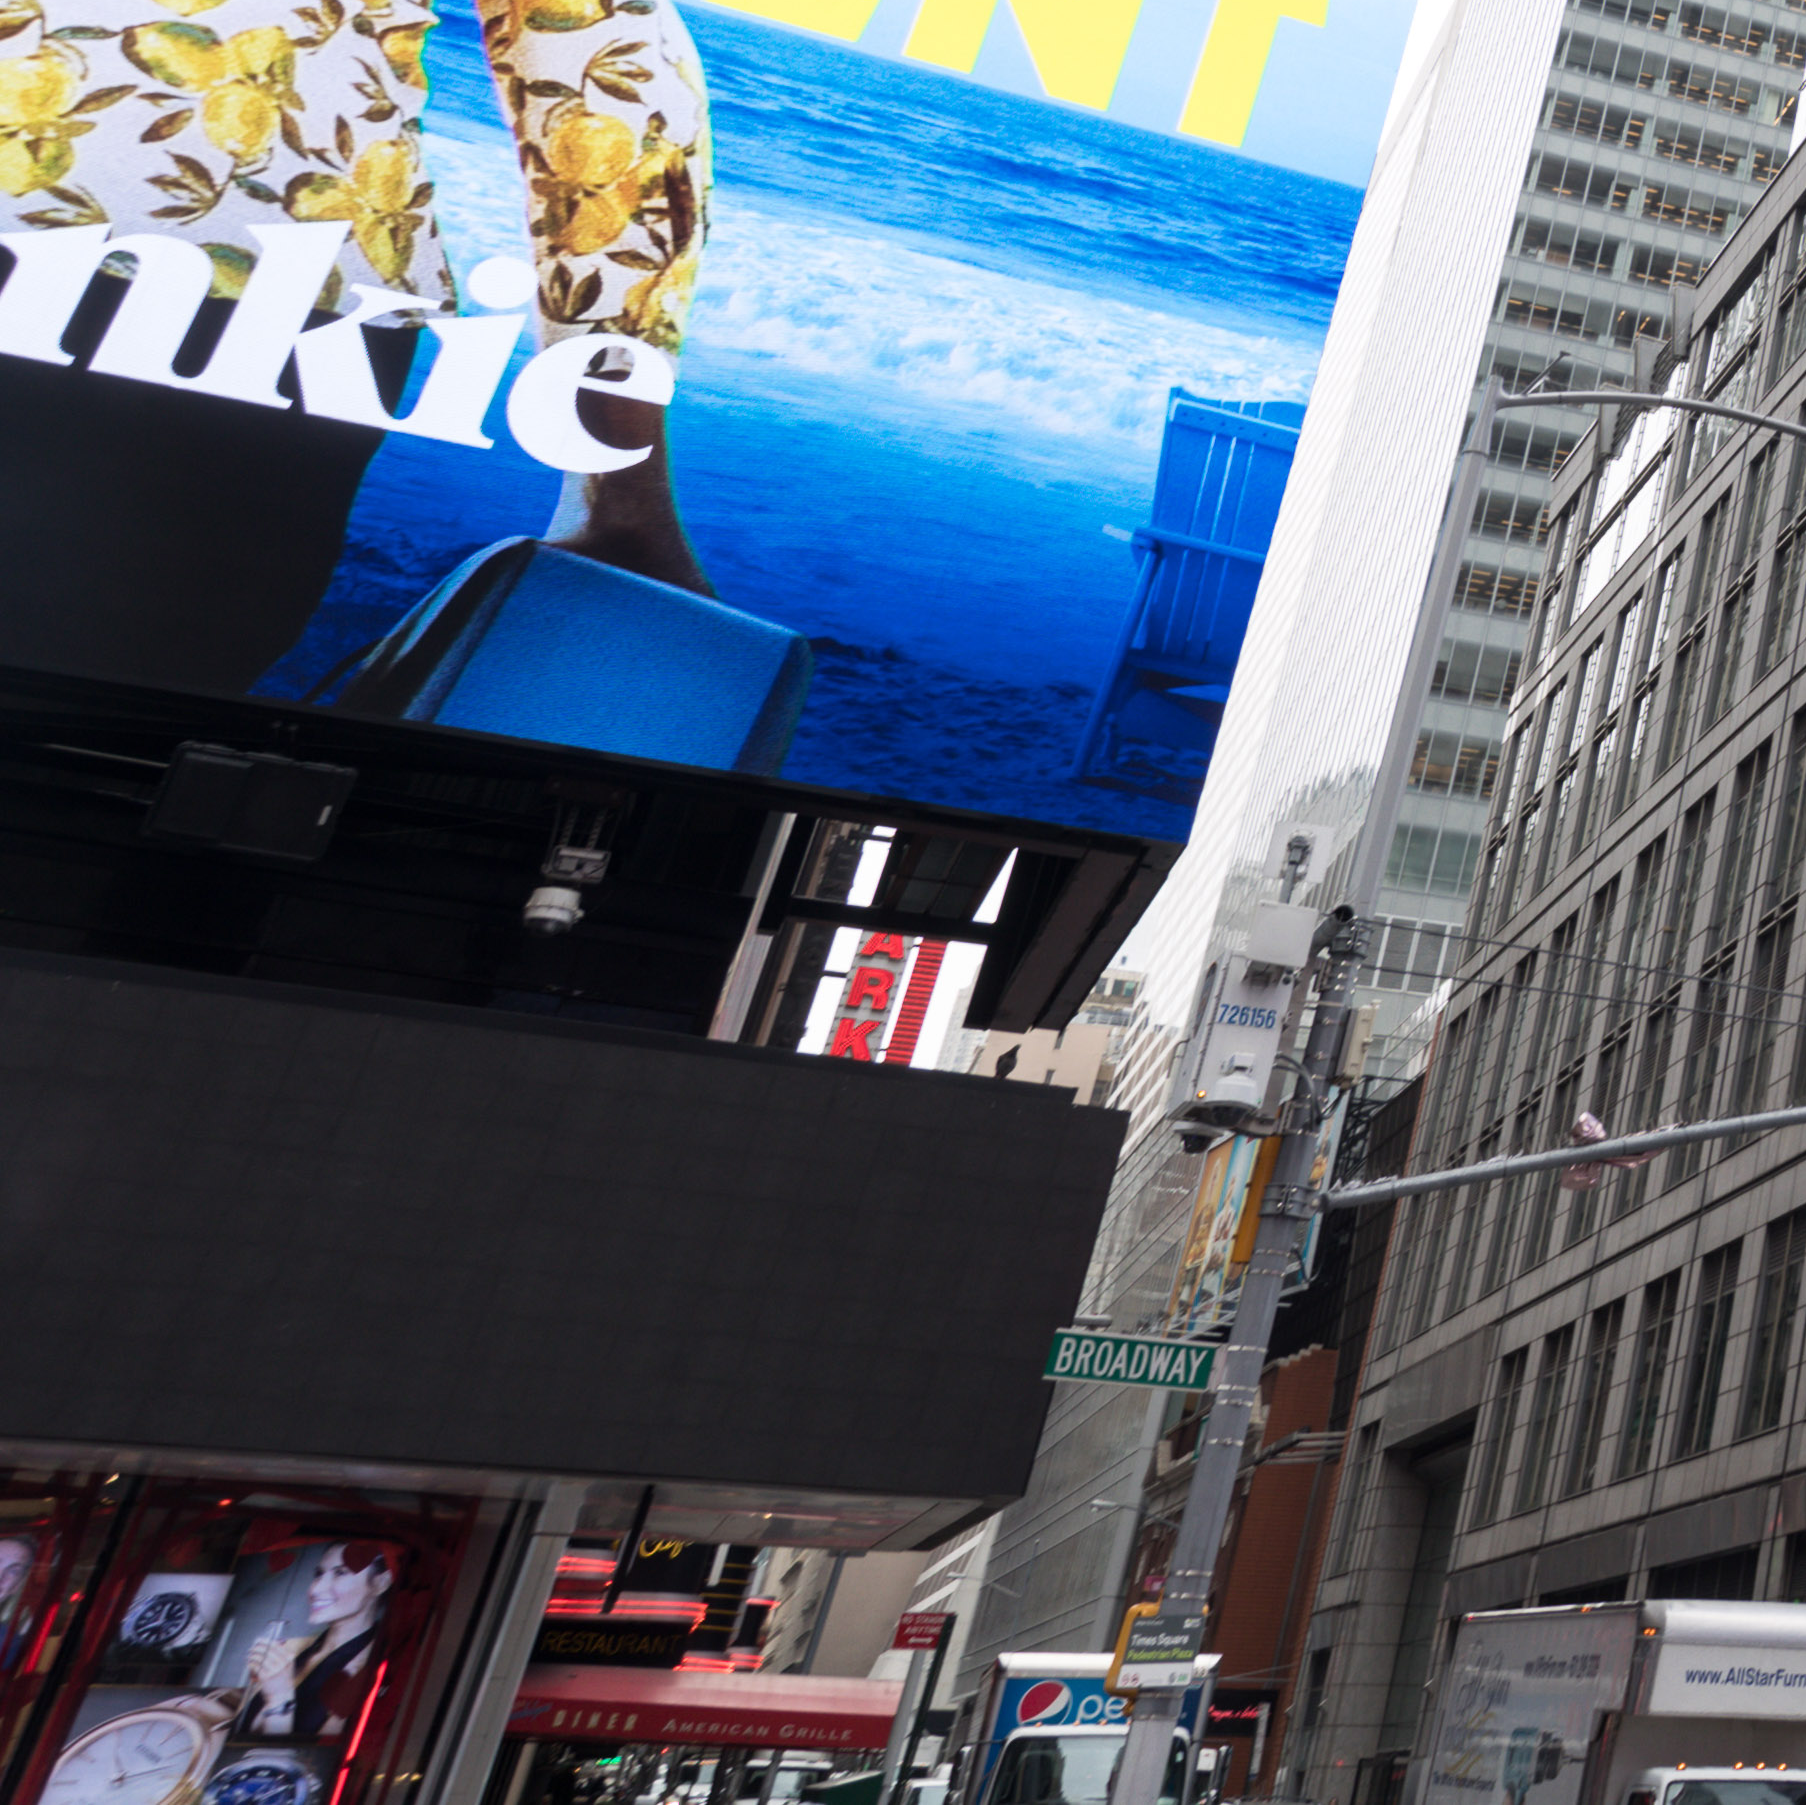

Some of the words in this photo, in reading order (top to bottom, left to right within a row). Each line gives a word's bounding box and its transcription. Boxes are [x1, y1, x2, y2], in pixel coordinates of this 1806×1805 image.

[1219, 1002, 1276, 1030] 726156
[1054, 1337, 1209, 1384] BROADWAY
[541, 1630, 684, 1656] RESTAURANT
[552, 1708, 639, 1733] DINER
[662, 1719, 772, 1738] AMERICAN
[780, 1723, 852, 1741] GRILLE
